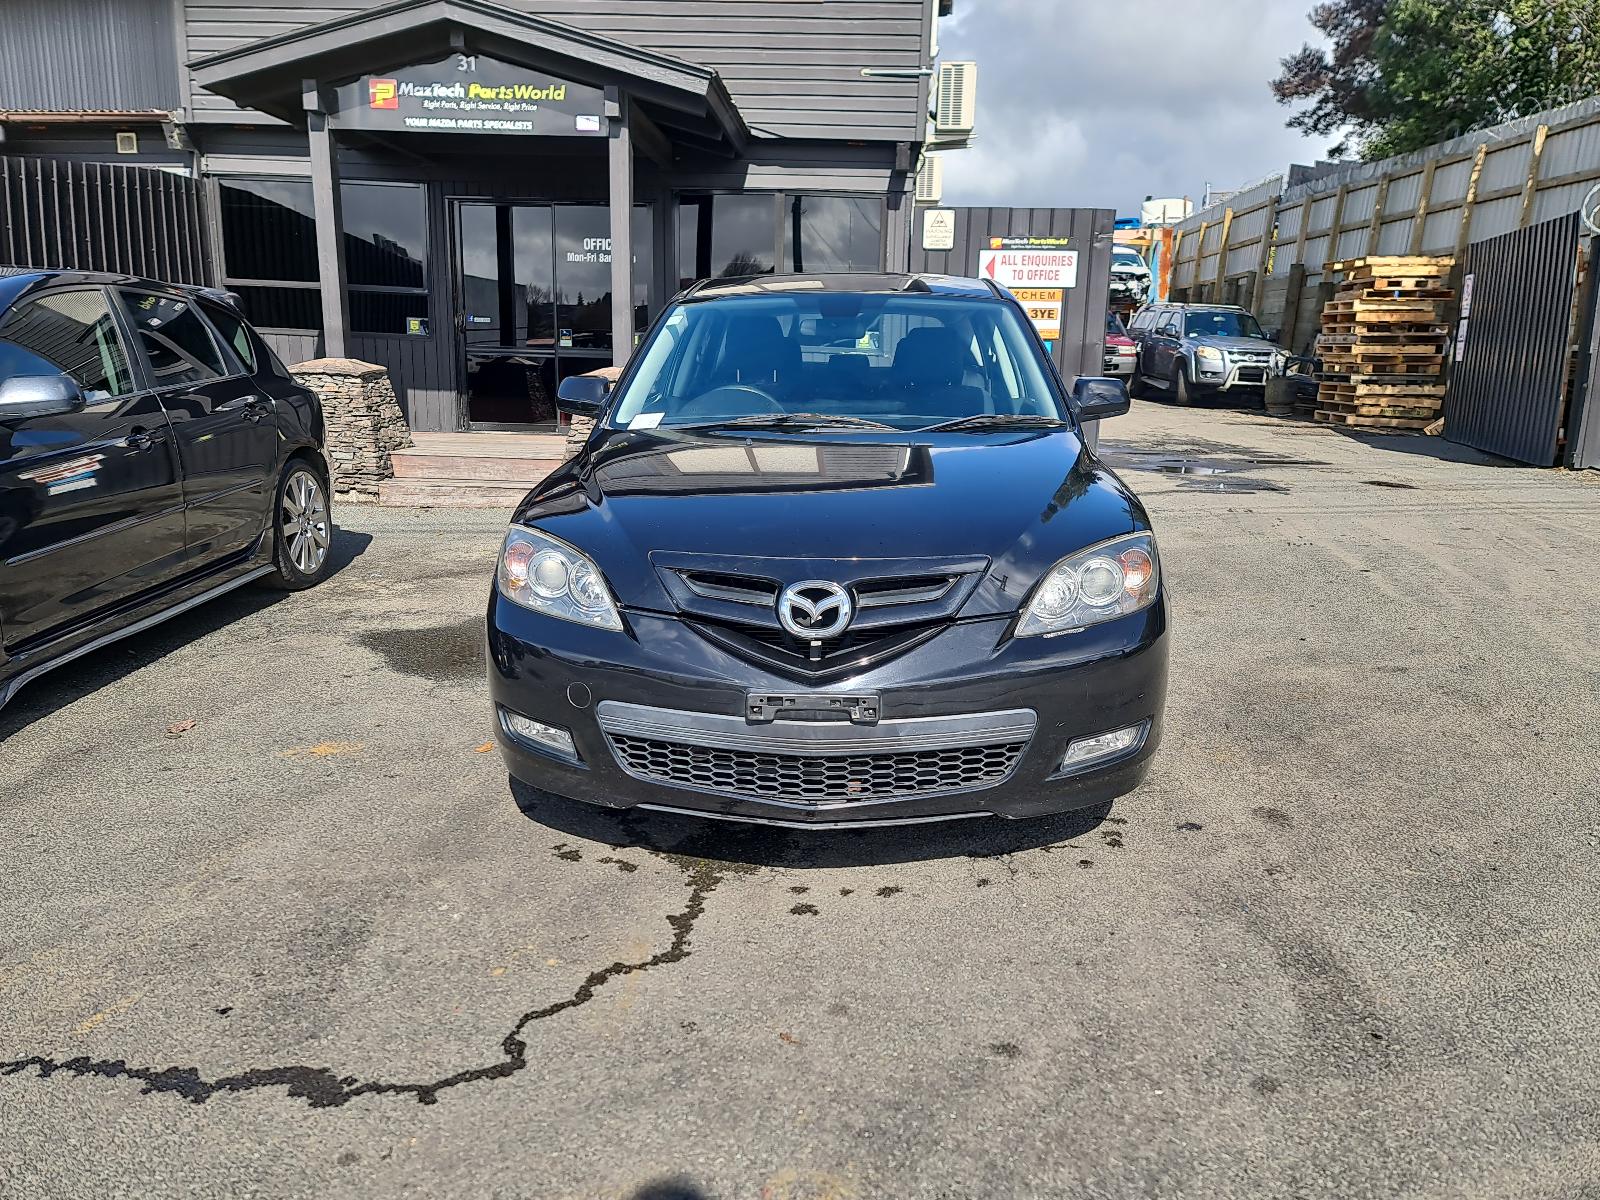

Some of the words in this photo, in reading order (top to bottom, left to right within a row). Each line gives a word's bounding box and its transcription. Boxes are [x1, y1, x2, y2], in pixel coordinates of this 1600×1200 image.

[457, 55, 476, 71] 31
[399, 82, 465, 98] MazTech
[468, 83, 567, 100] PartsWorld
[422, 99, 440, 110] Right
[460, 100, 476, 111] Right
[478, 101, 502, 112] Service,
[503, 102, 520, 112] Right
[521, 102, 538, 112] Price
[404, 117, 428, 127] YOUR
[428, 118, 456, 128] MAZDA
[457, 119, 482, 129] PARTS
[483, 120, 533, 130] SPECIALISTS
[567, 252, 597, 262] Mon-Fri
[1001, 254, 1018, 267] ALL
[1021, 255, 1074, 267] ENQUIRIES
[1012, 269, 1024, 281] TO
[1027, 269, 1060, 281] OFFICE
[1030, 309, 1055, 319] 3YE
